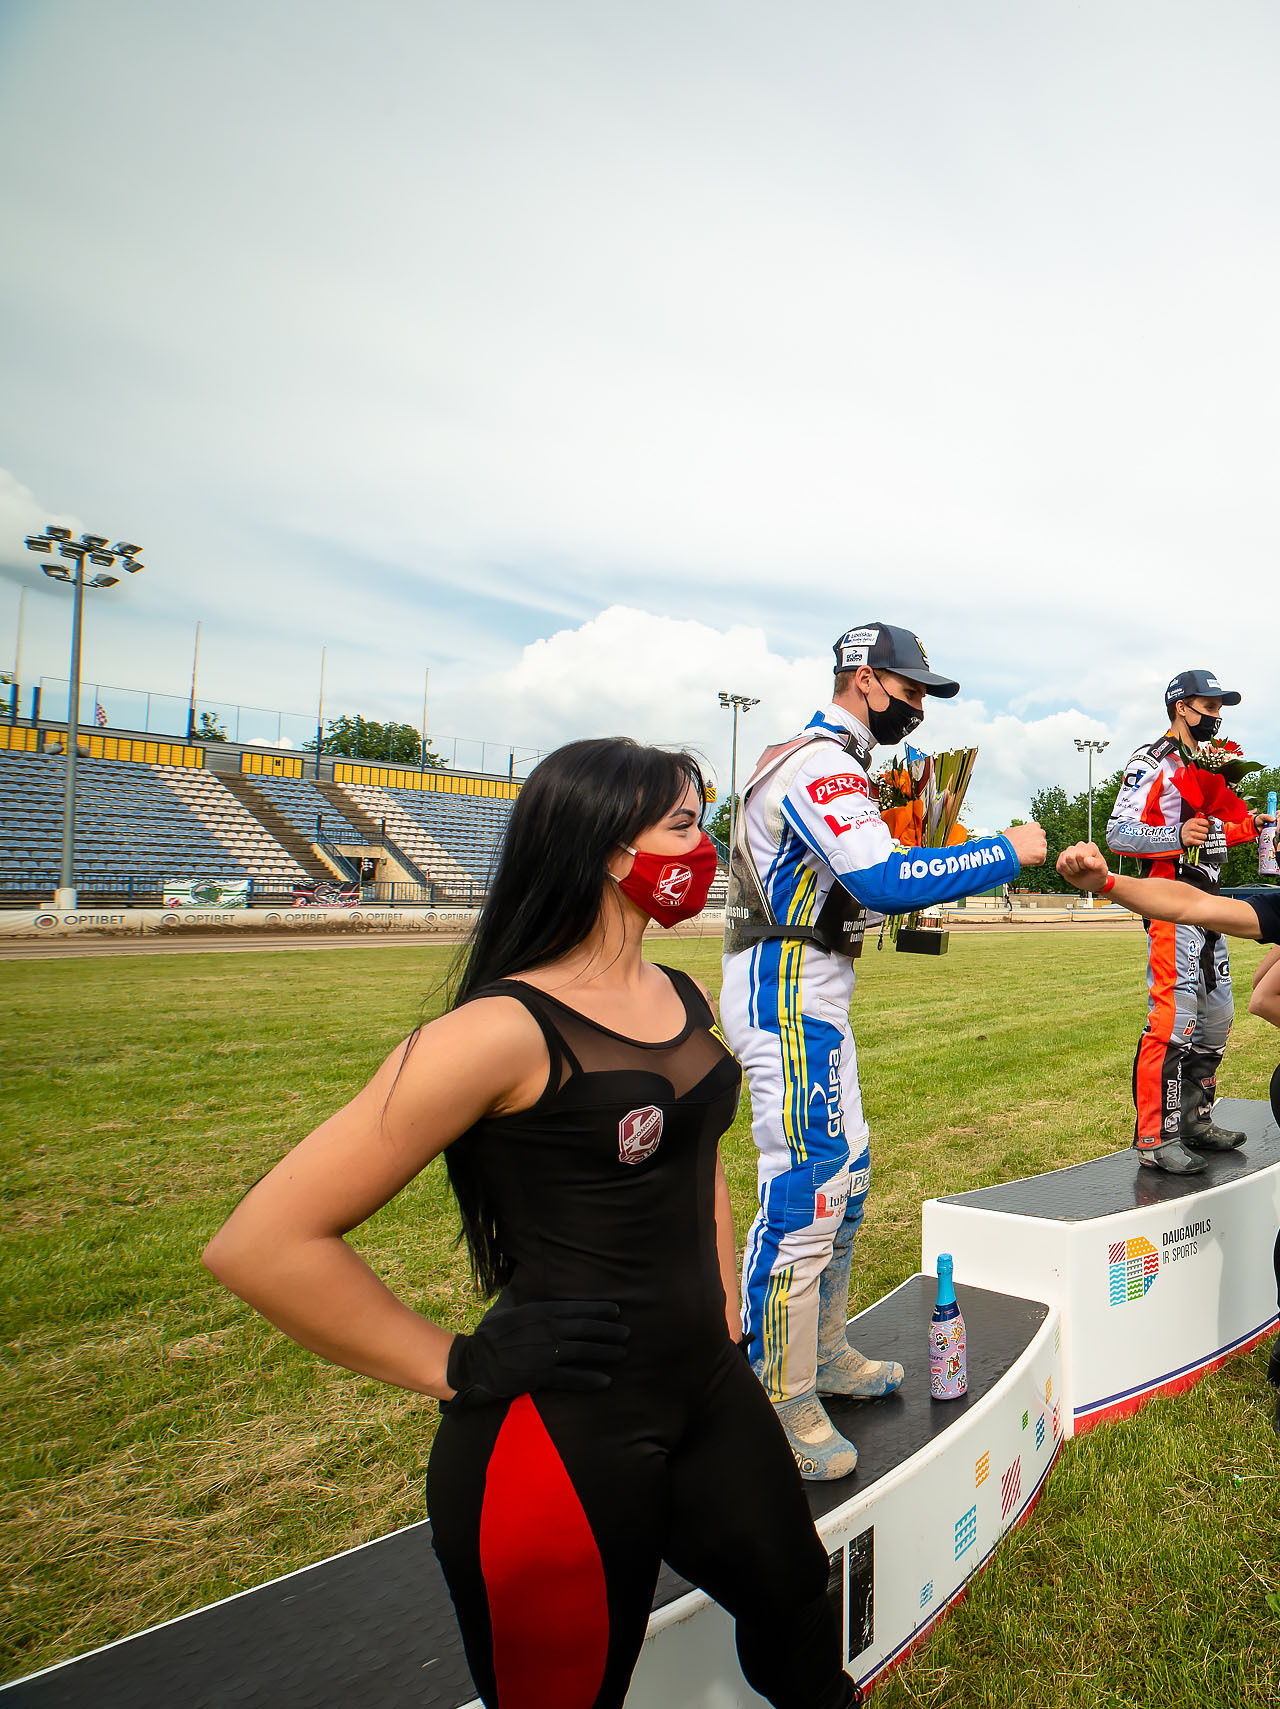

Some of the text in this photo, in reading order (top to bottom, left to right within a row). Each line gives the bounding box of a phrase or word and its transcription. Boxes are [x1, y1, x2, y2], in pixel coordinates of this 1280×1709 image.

[899, 845, 1006, 880] BOGDANKA
[63, 914, 126, 926] OPTIBET
[184, 914, 236, 925] OPTIBET
[283, 912, 328, 923] OPTIBET
[366, 912, 403, 922] OPTIBET
[440, 912, 473, 921] OPTIBET
[1166, 1080, 1178, 1110] BMW
[624, 1111, 658, 1147] LOKOMOTIV
[1162, 1218, 1212, 1247] DAUGAVPILS
[1162, 1241, 1198, 1265] IR SPORTS
